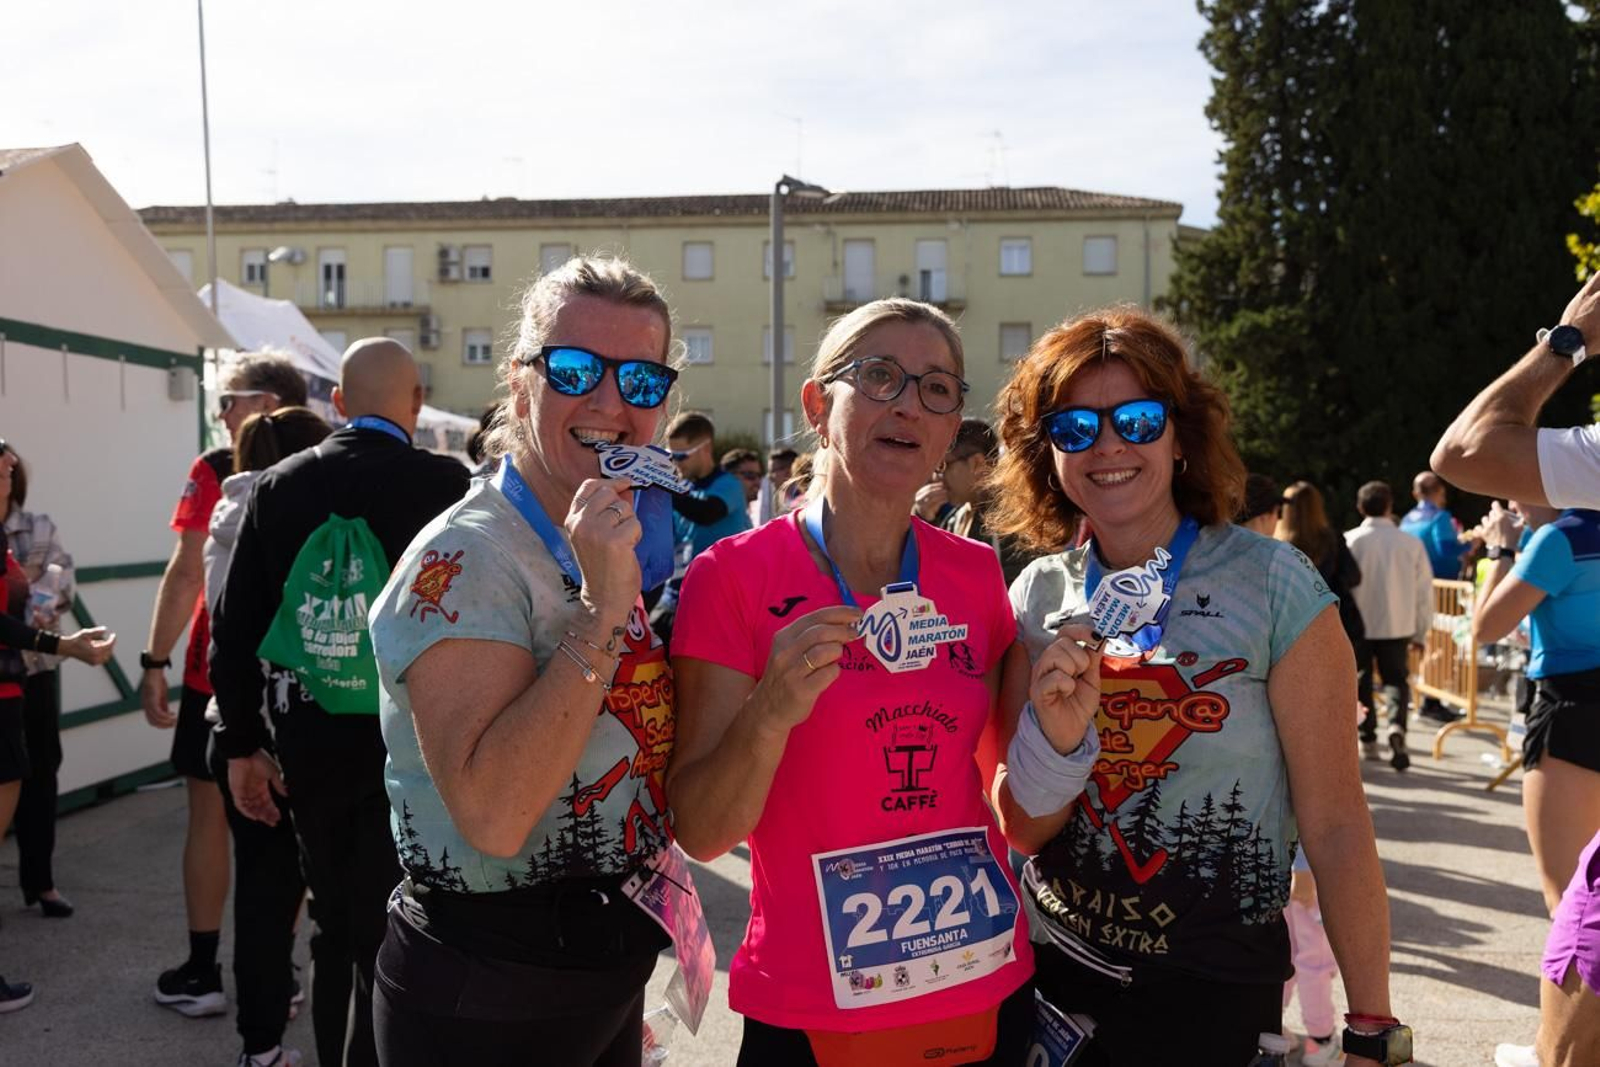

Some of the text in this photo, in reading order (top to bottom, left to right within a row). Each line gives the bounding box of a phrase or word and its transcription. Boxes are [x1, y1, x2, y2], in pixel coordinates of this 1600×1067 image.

[909, 616, 948, 631] MEDIA
[1097, 597, 1121, 636] MARAT
[1107, 603, 1131, 636] MEDIA
[905, 646, 935, 660] JAÉN
[908, 627, 966, 646] MARATÓN
[866, 700, 959, 733] Macchiato
[895, 850, 916, 861] MEDIA
[842, 868, 1000, 948] 2221
[1051, 876, 1176, 929] ARAISO
[901, 929, 968, 953] FUENSANTA
[1099, 922, 1169, 955] EXTRA
